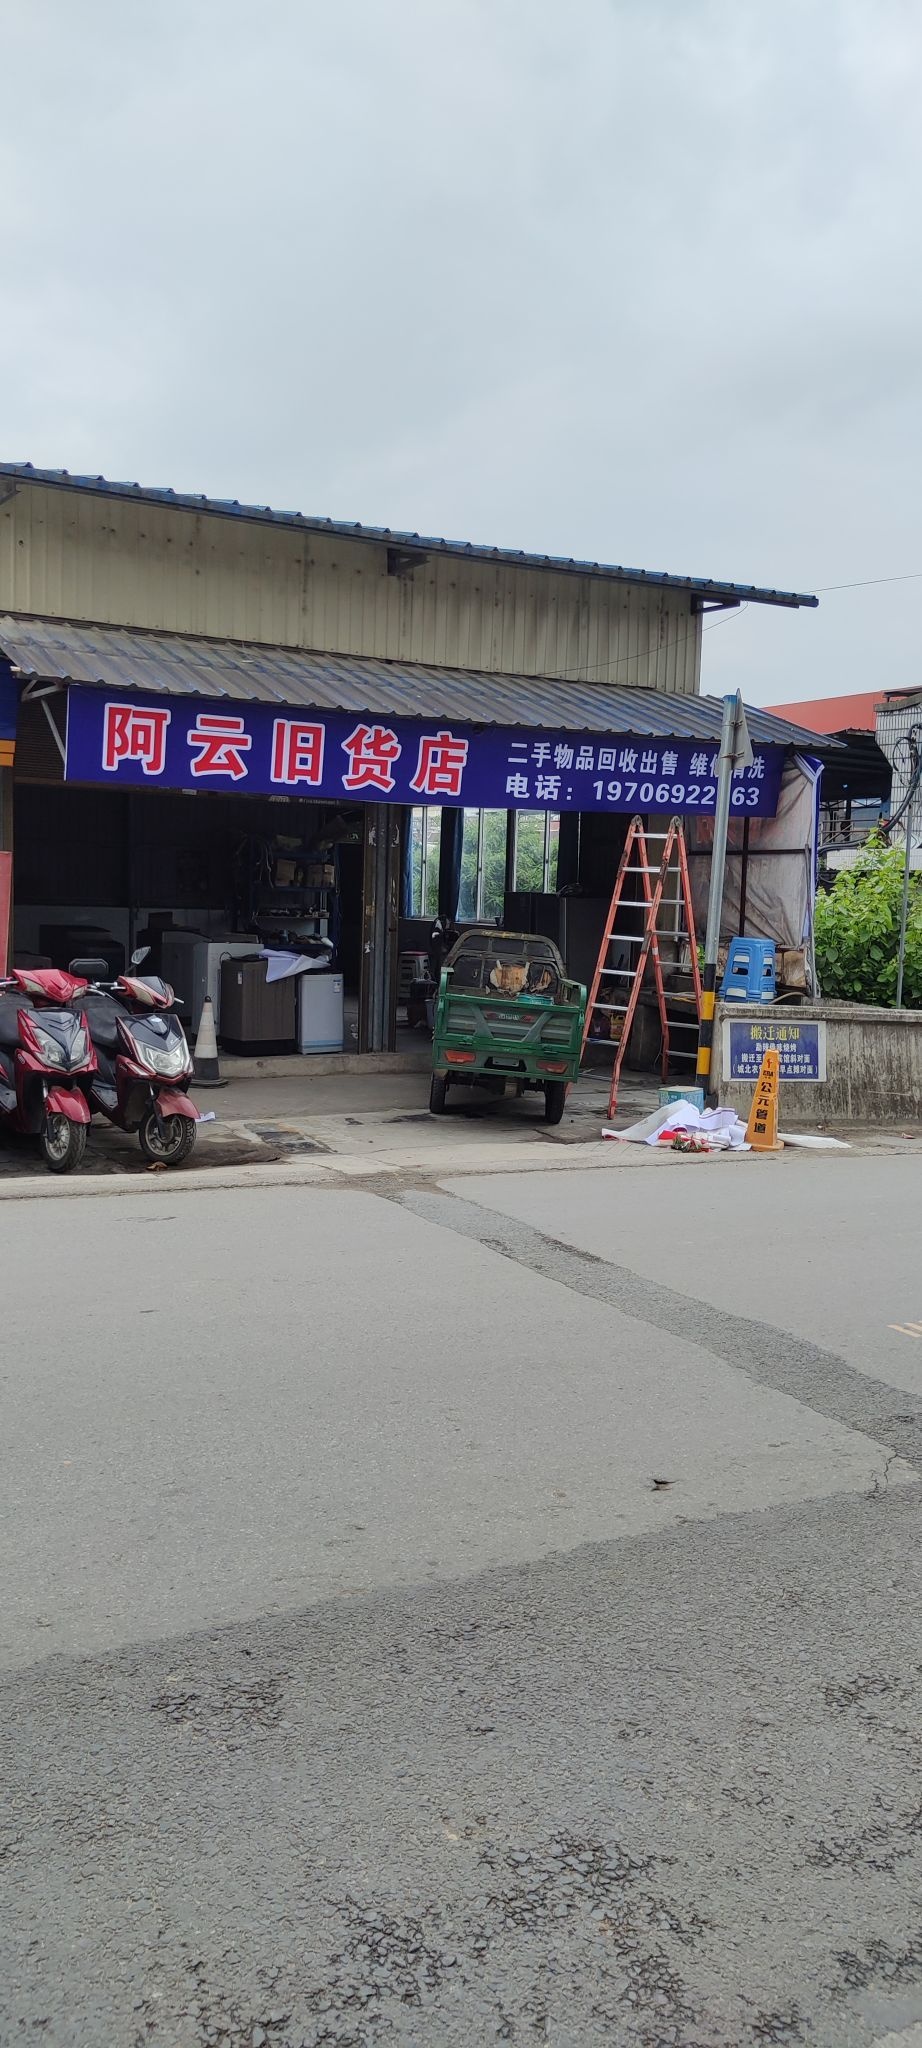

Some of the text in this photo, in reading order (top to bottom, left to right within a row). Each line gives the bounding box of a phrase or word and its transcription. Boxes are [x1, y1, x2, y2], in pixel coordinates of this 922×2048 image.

[102, 703, 468, 796] 阿云旧货店
[508, 742, 678, 776] 二手物品回收出售
[593, 780, 760, 806] 1970692263
[750, 1025, 800, 1040] 搬迁通知
[753, 1081, 773, 1134] 公元管道
